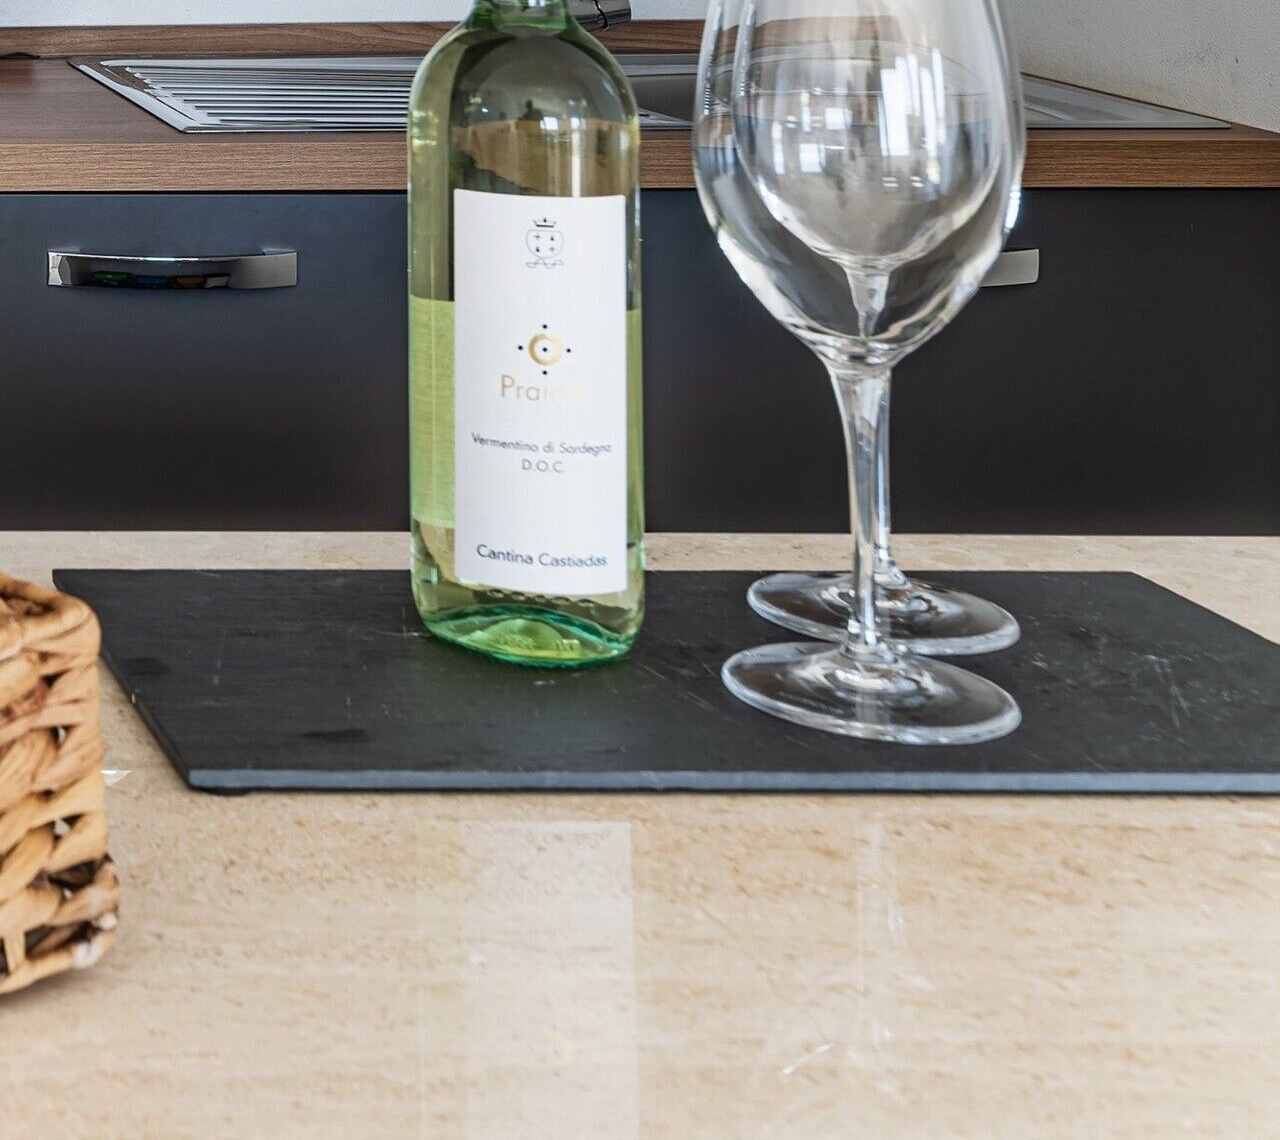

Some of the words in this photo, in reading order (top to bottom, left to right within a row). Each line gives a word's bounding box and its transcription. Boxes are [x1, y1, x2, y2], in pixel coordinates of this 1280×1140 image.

[471, 431, 539, 452] Vermentino
[543, 442, 554, 453] di
[559, 442, 611, 457] Sardegna
[476, 543, 533, 565] Cantina
[538, 552, 607, 568] Castiadas
